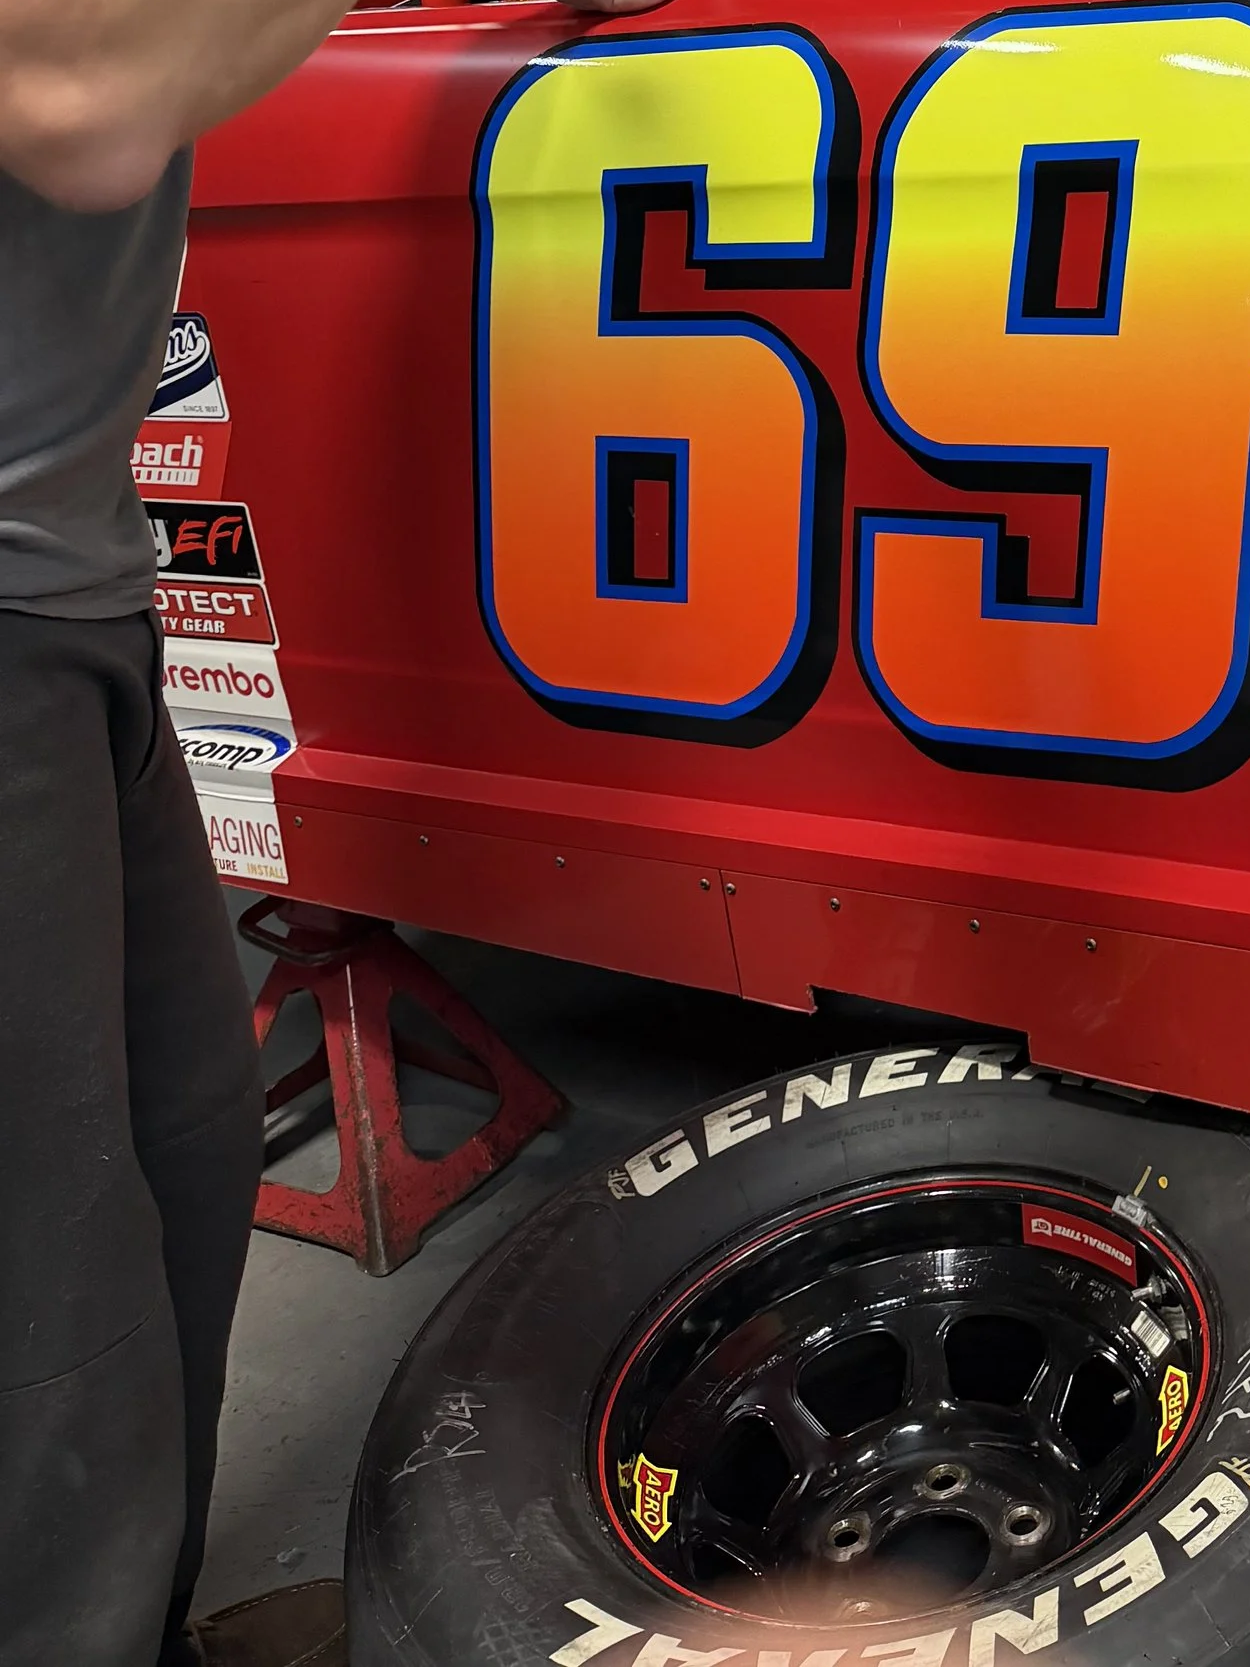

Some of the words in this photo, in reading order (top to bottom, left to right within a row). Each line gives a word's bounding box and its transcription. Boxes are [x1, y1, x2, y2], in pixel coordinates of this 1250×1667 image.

[172, 515, 243, 565] EFI
[183, 617, 226, 634] GEAR
[247, 862, 287, 881] INSTALL
[1053, 1224, 1082, 1242] TIRE
[1082, 1233, 1133, 1266] GENERAL
[1167, 1380, 1182, 1431] AERO
[643, 1469, 662, 1526] AERO
